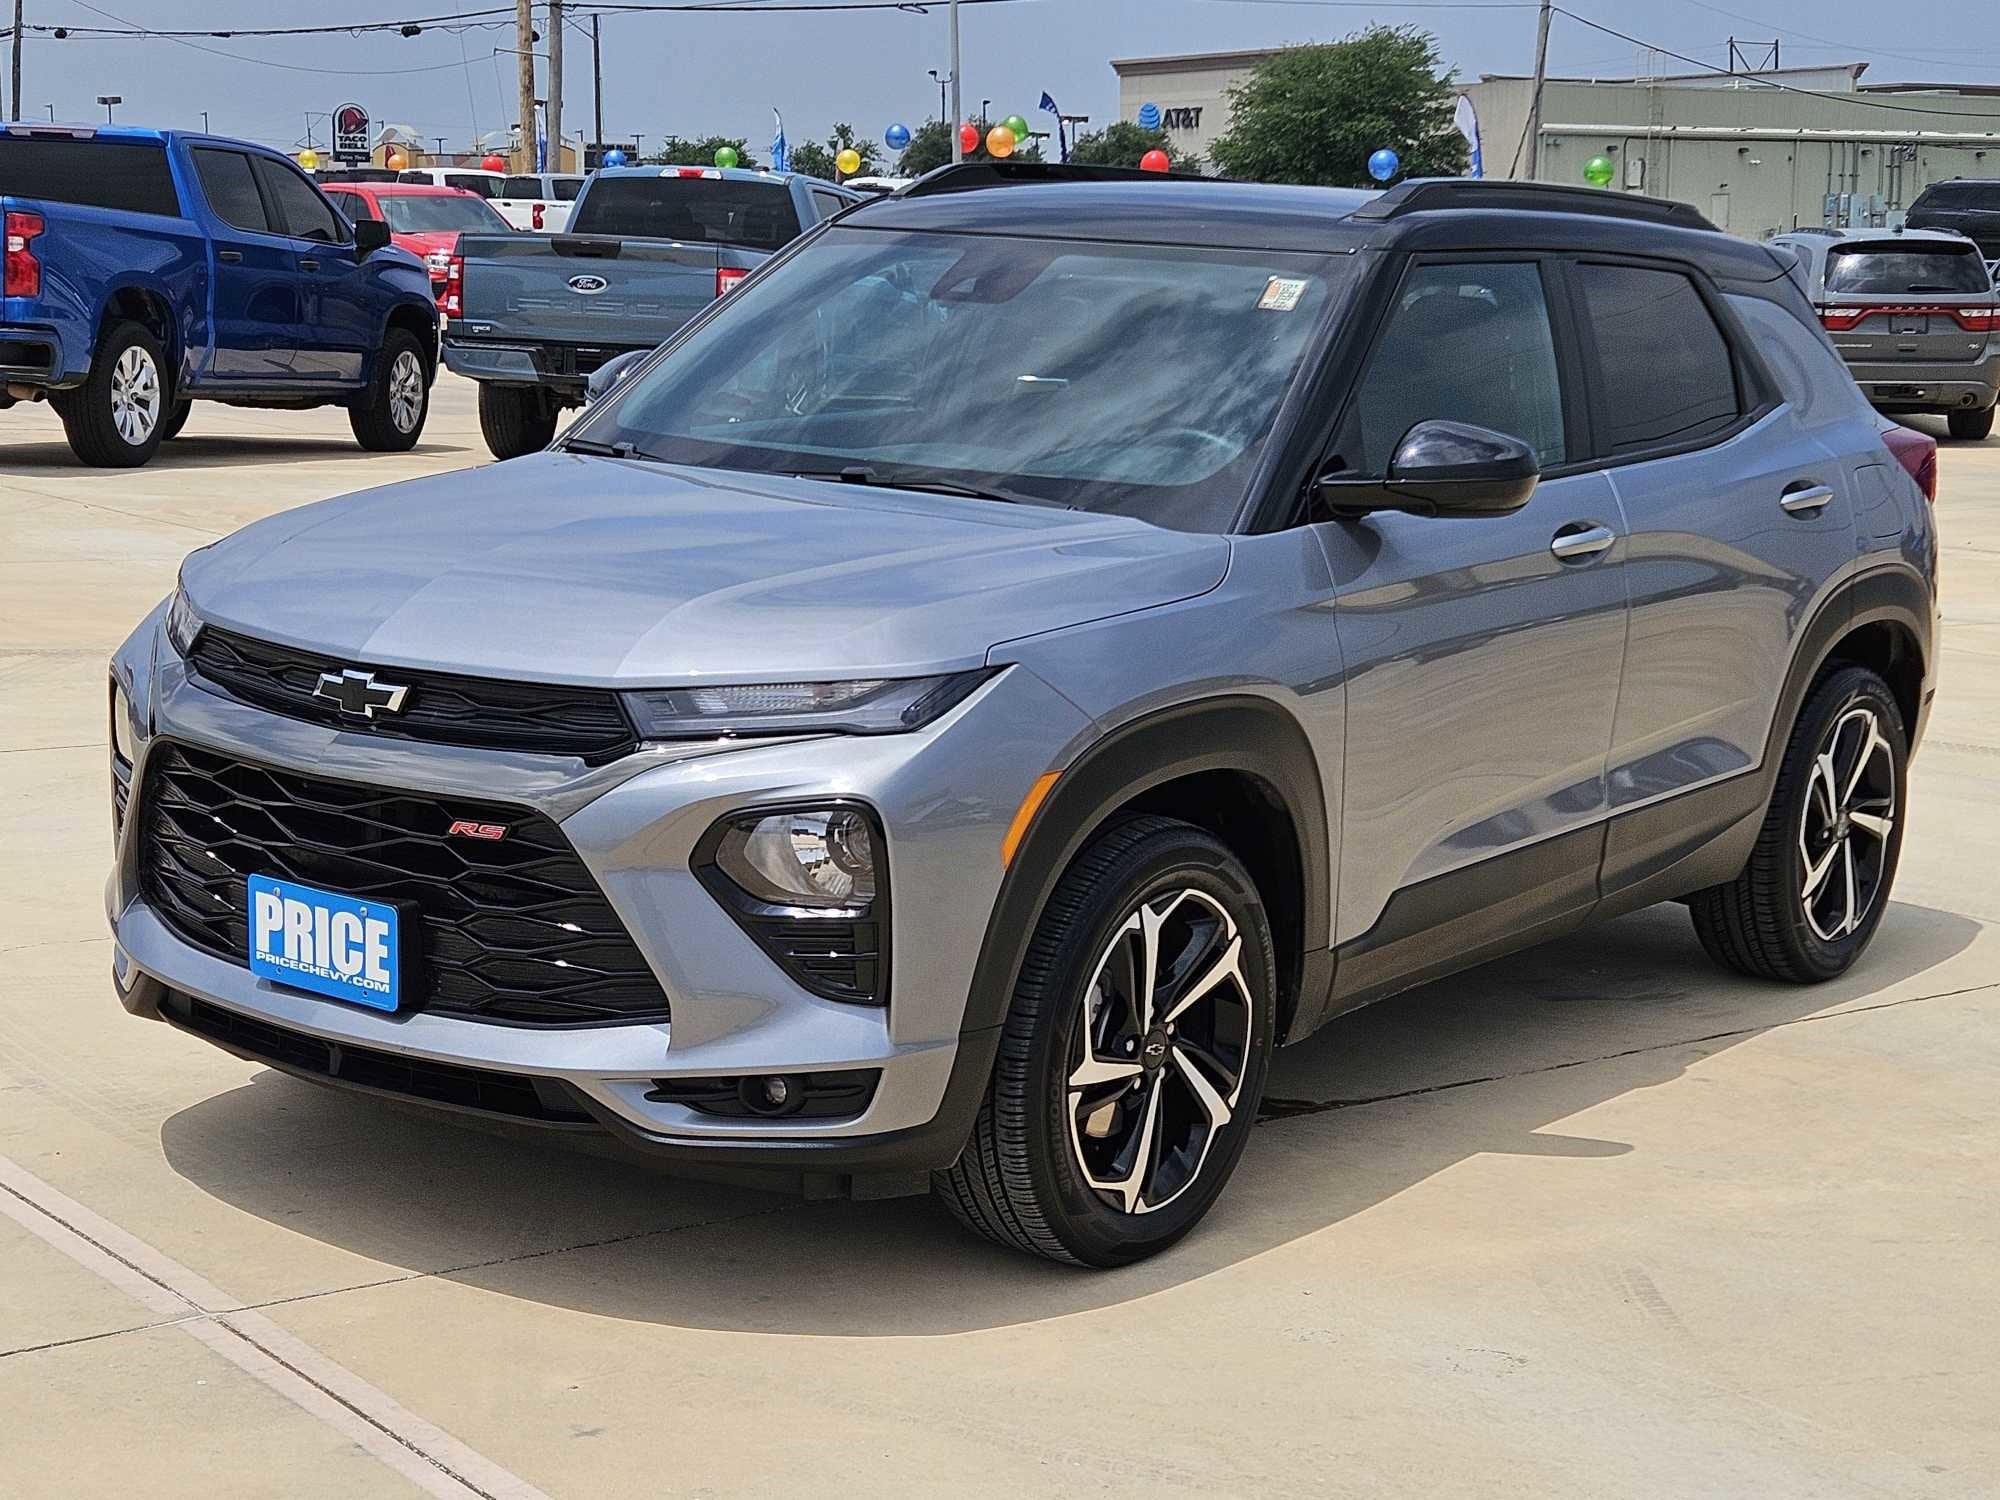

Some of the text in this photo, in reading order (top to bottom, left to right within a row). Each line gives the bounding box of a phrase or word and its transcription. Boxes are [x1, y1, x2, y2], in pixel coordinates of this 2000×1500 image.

[1161, 106, 1203, 129] AT&T
[576, 278, 597, 289] Ford
[449, 821, 506, 839] RS
[256, 891, 390, 983] PRICE
[256, 951, 390, 993] PRICECHEVY.COM
